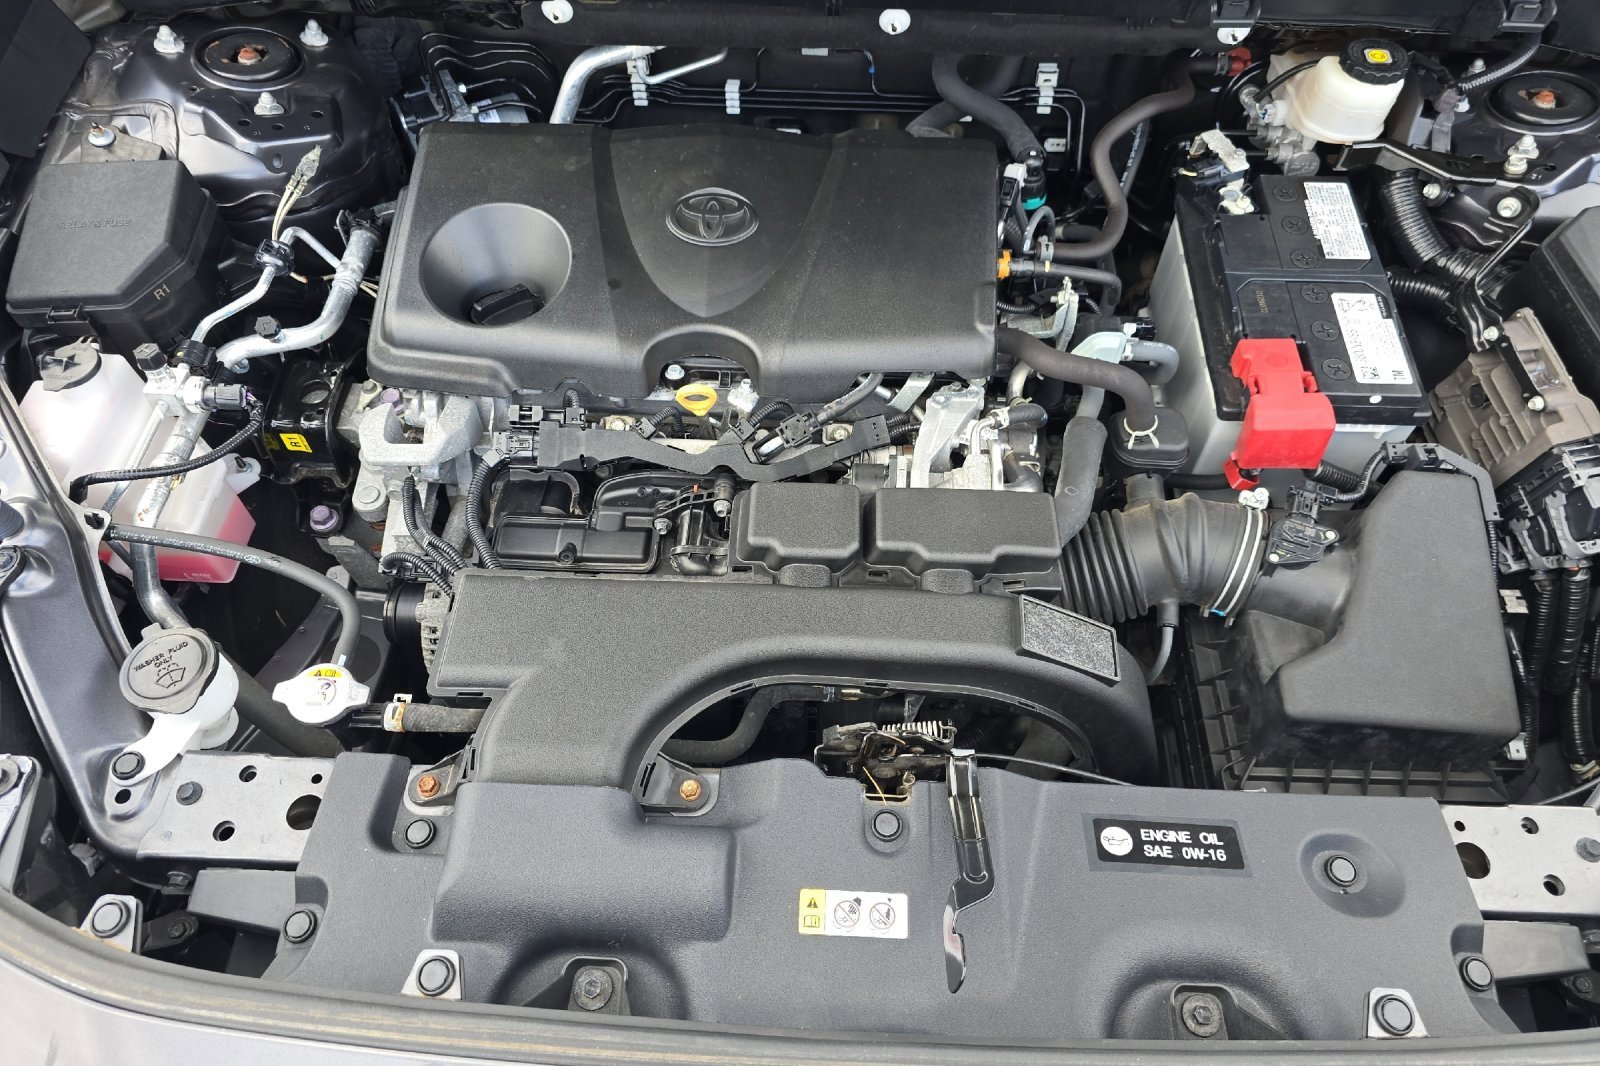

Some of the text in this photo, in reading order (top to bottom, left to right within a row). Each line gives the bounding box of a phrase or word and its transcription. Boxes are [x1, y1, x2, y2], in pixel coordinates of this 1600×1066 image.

[153, 283, 171, 301] R1
[286, 436, 302, 448] R1
[133, 652, 165, 672] WASHER
[154, 655, 173, 668] ONLY
[1140, 828, 1225, 846] ENGINE OIL
[1143, 844, 1227, 862] SAE 0W-16
